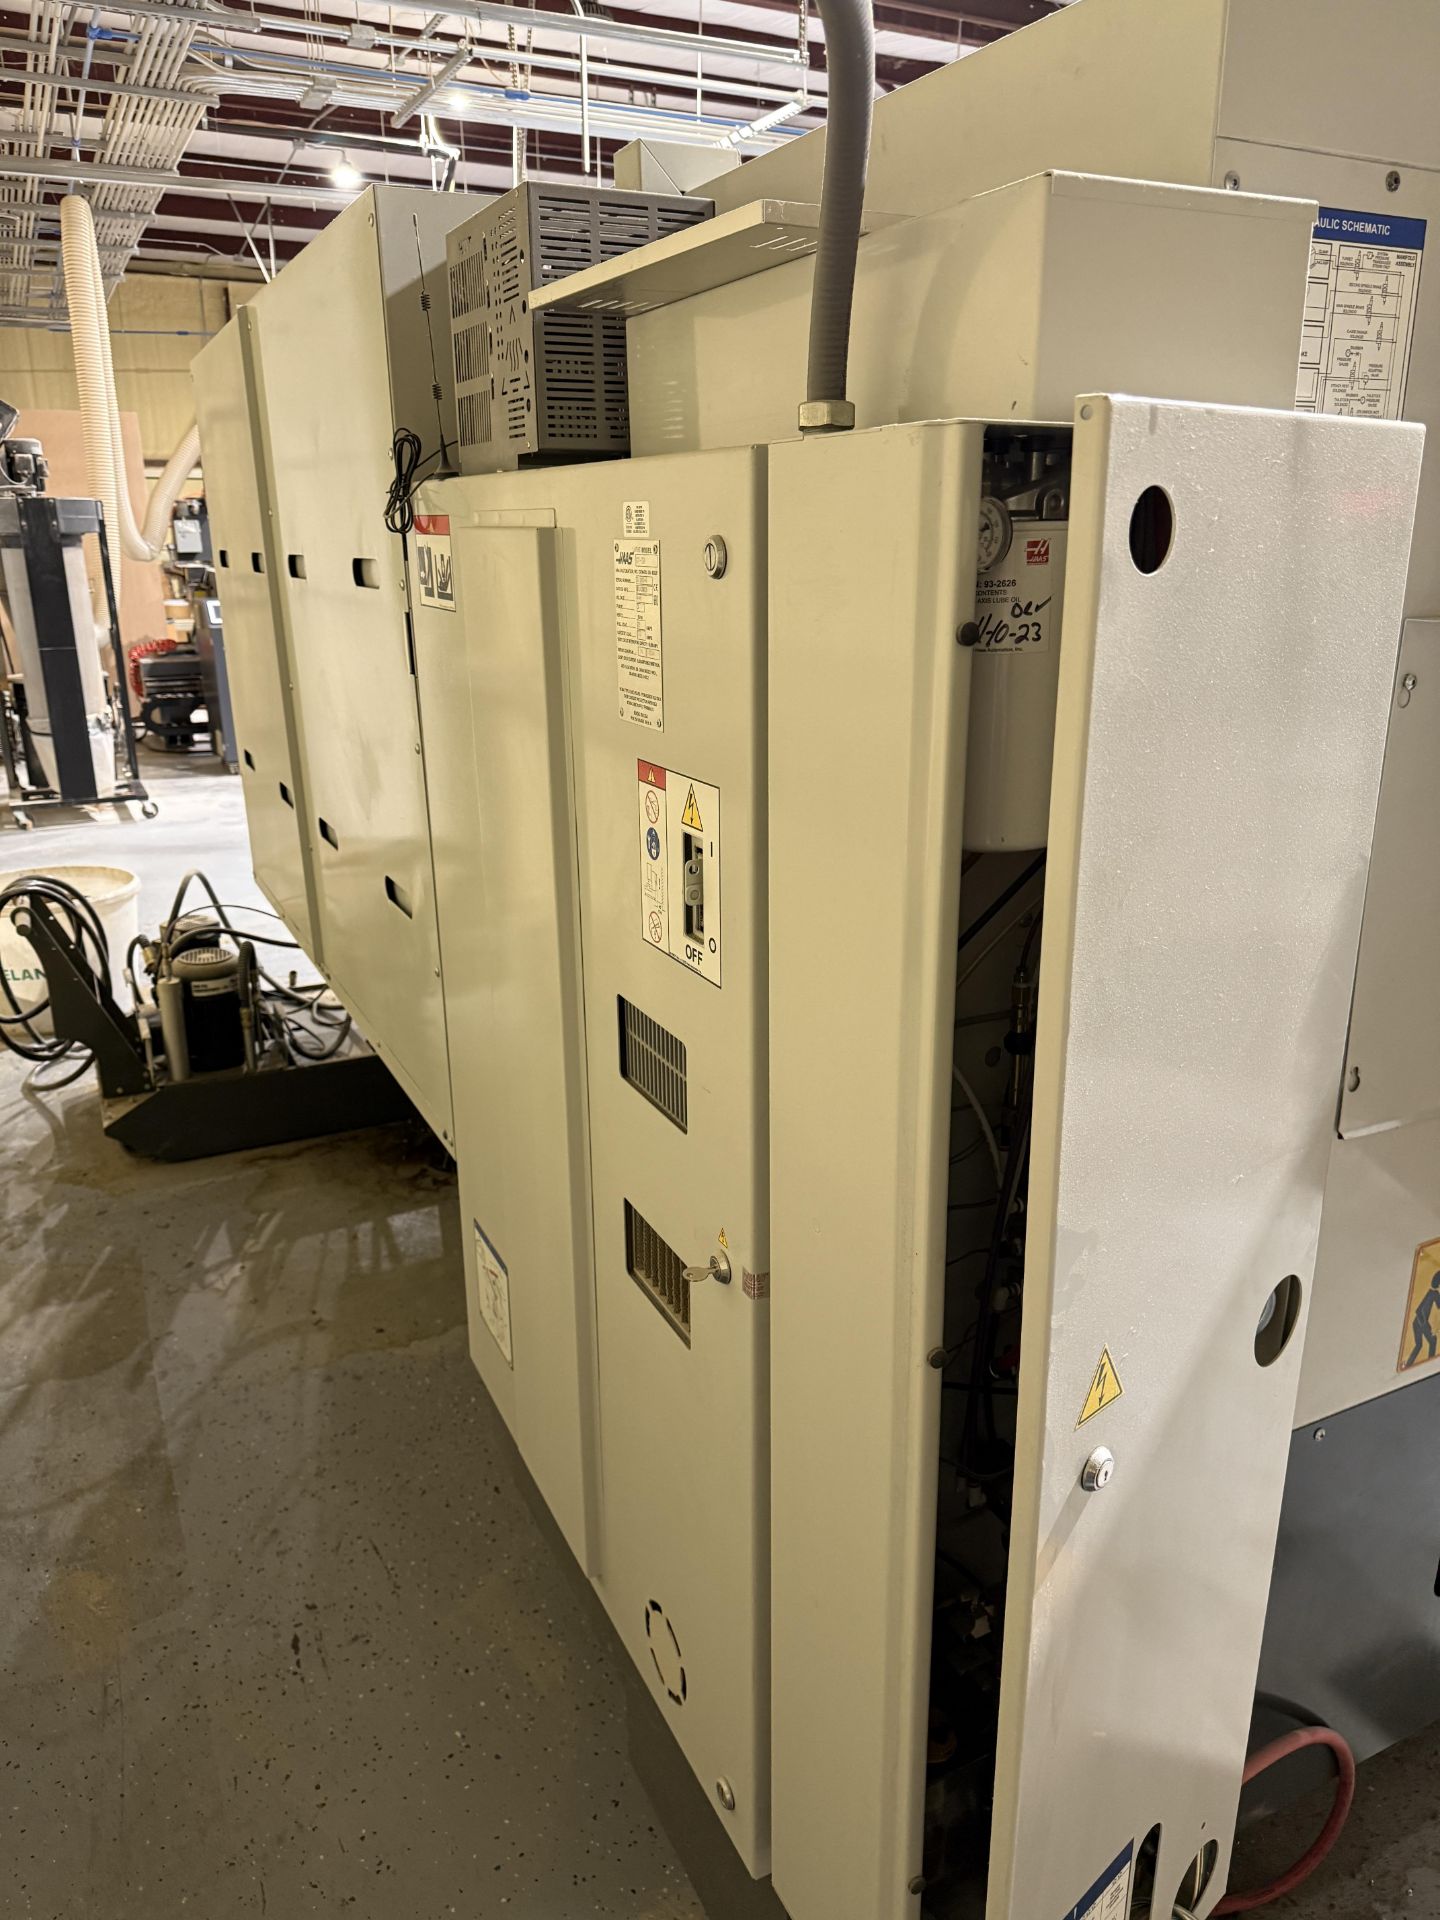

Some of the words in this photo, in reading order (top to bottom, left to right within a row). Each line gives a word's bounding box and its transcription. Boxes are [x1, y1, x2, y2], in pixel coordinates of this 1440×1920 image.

[1341, 220, 1391, 236] SCHEMATIC
[984, 579, 1017, 588] 93-2626
[685, 944, 703, 965] OFF
